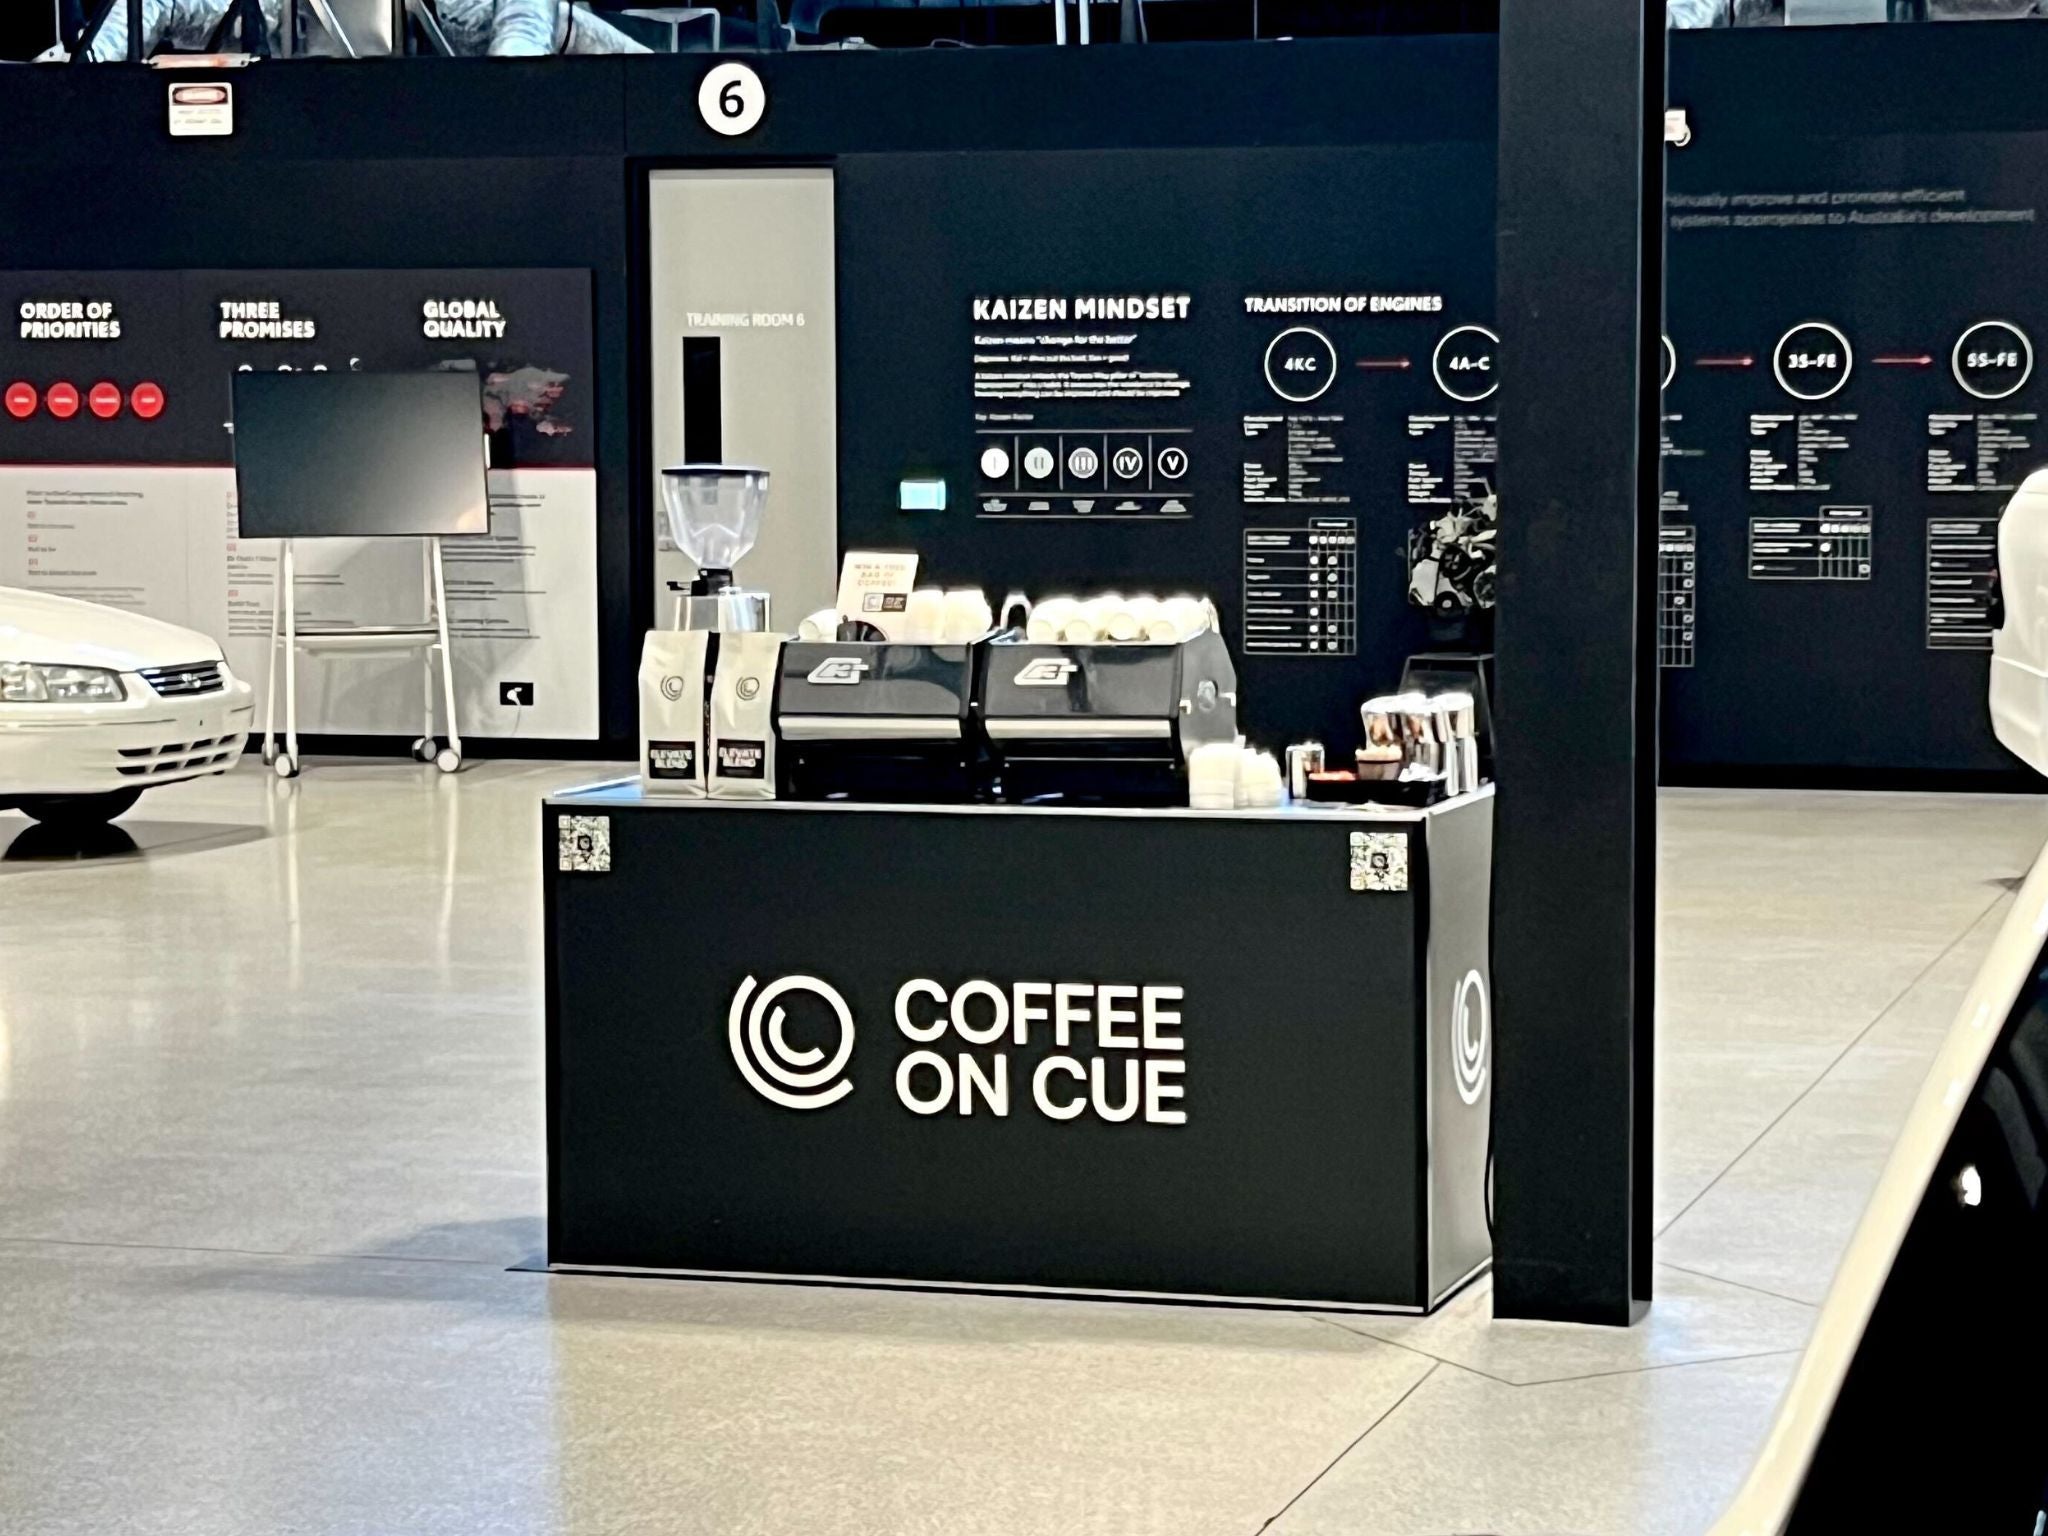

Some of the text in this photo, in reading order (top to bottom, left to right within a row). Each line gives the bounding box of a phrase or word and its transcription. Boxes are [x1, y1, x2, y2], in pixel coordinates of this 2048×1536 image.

[718, 79, 744, 118] 6
[20, 302, 114, 319] ORDER OF
[220, 301, 280, 319] THREE
[424, 300, 500, 319] GLOBAL
[973, 296, 1191, 320] KAIZEN MINDSET
[1244, 296, 1443, 313] TRANSITION OF ENGINES
[687, 312, 805, 328] TRAINING ROOM 6
[20, 320, 121, 339] PRIORITIES
[219, 320, 316, 339] PROMISES
[424, 320, 507, 339] QUALITY
[1284, 357, 1317, 371] 4KC
[1449, 356, 1490, 371] 4A-C
[1119, 456, 1137, 471] IV
[1166, 455, 1179, 471] V
[894, 978, 1185, 1052] COFFEE
[895, 1051, 1188, 1125] ON CUE
